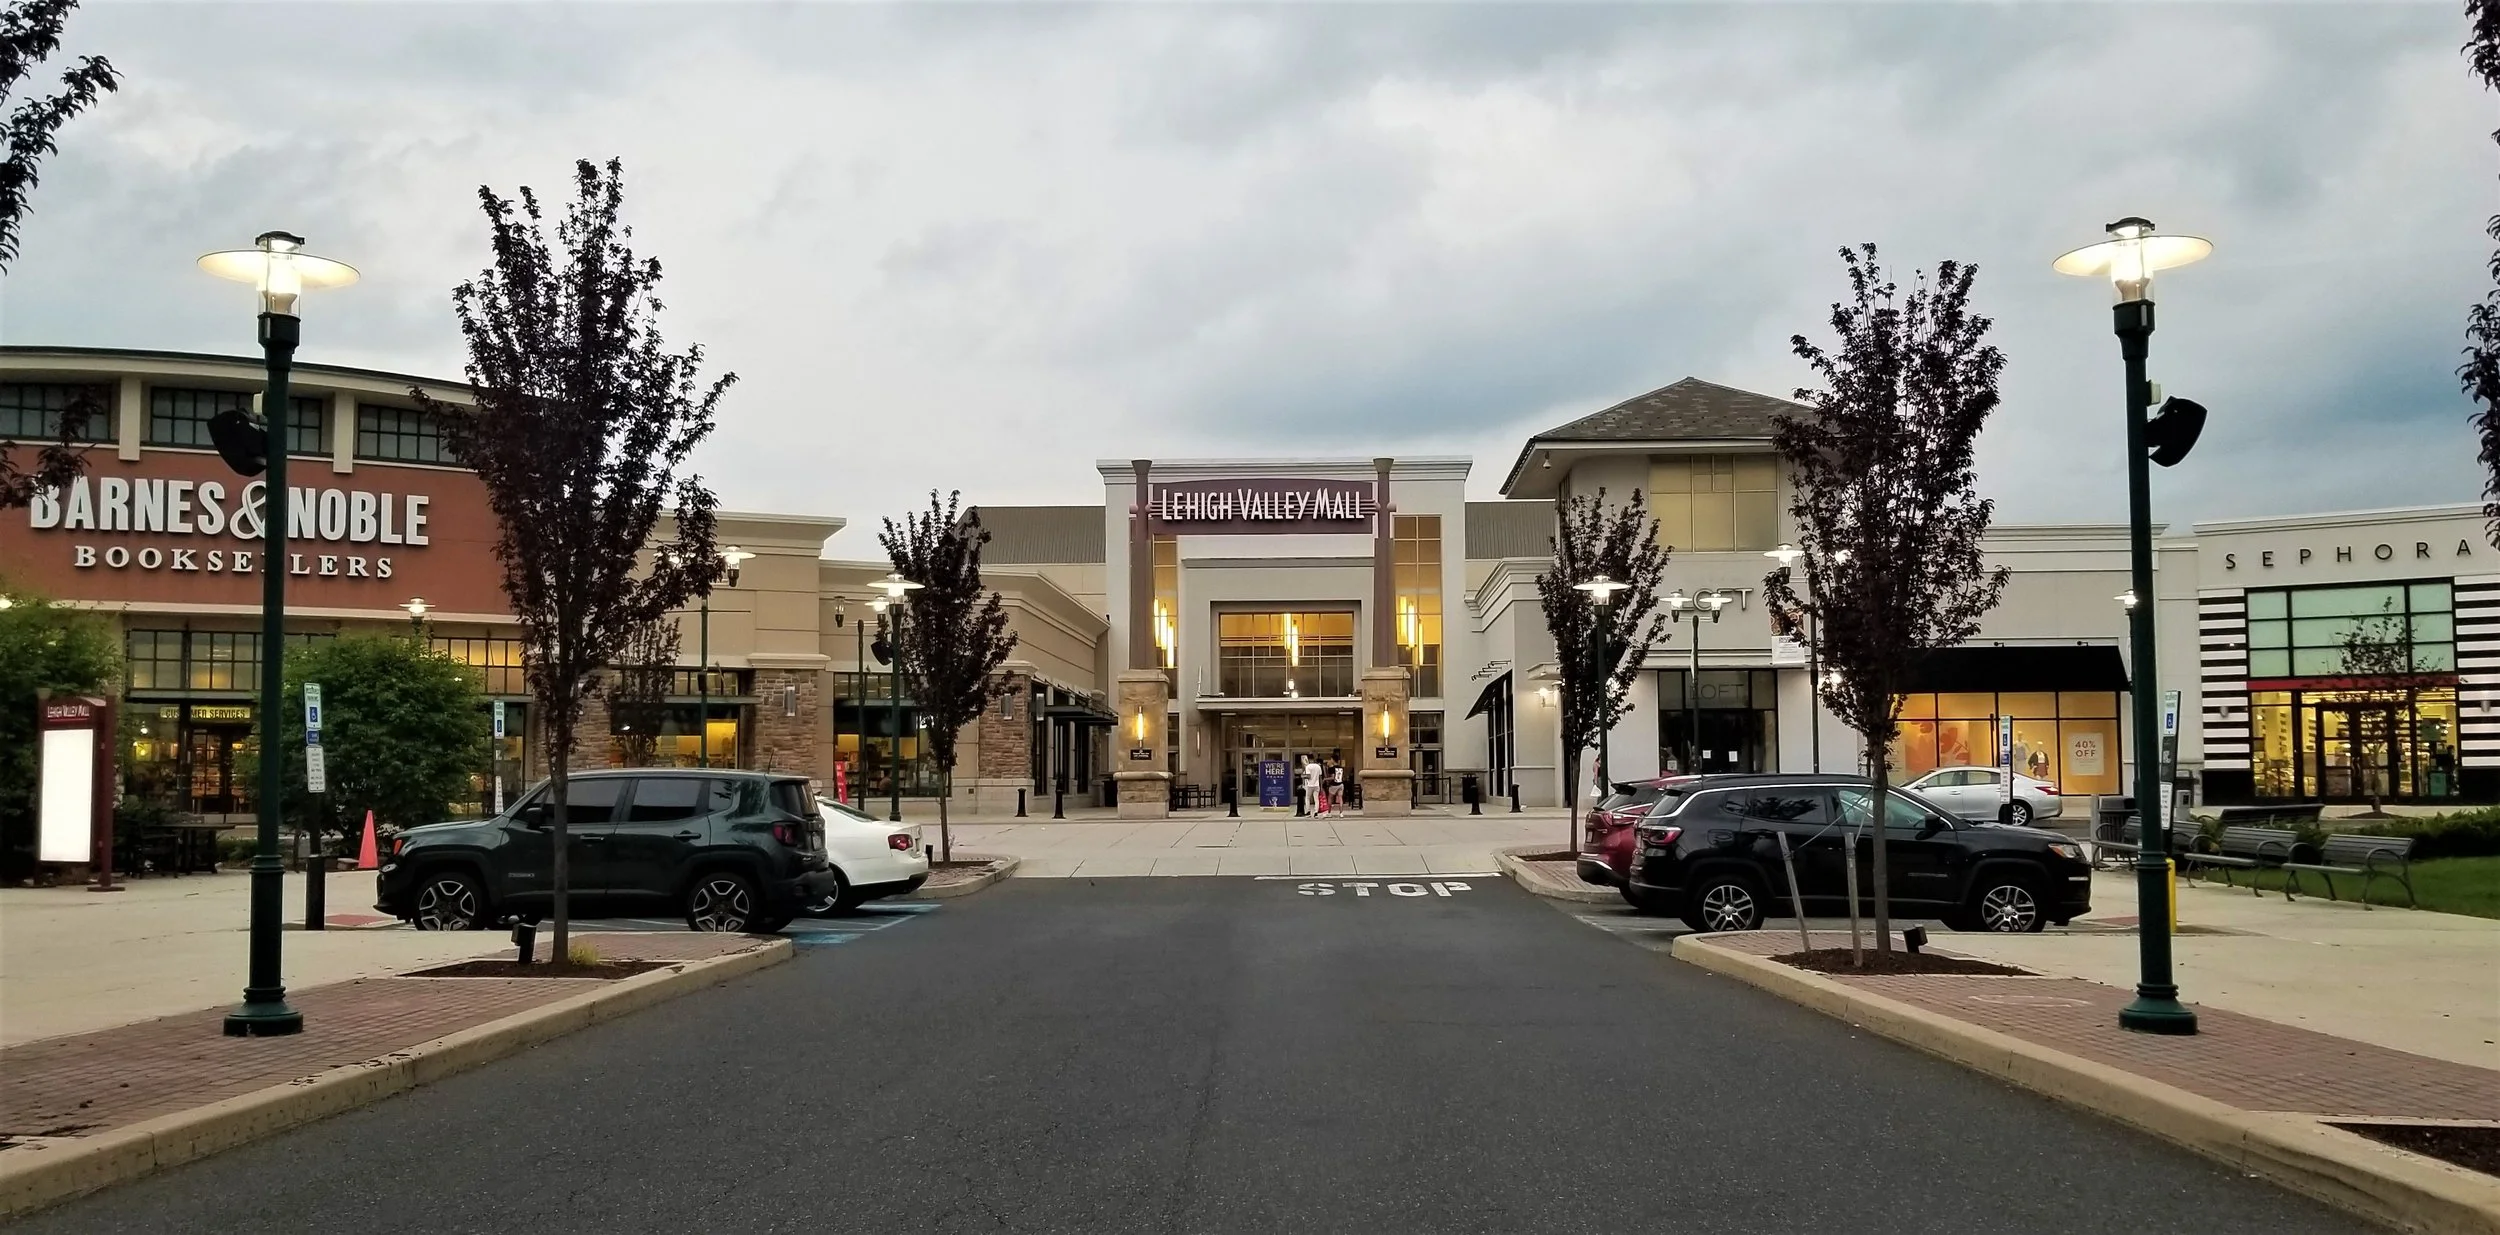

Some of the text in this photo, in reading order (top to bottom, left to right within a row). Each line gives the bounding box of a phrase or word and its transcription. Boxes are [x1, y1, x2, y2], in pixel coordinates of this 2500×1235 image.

[30, 474, 430, 546] BARNES & NOBLE
[1162, 487, 1365, 521] LEHIGH VALLEY MALL
[74, 545, 393, 579] BOOKSELERS
[2225, 539, 2472, 570] SEPHORA
[209, 708, 246, 719] SERVICES
[2075, 740, 2096, 749] 40%
[2075, 749, 2096, 758] OFF
[1297, 881, 1472, 897] STOP
